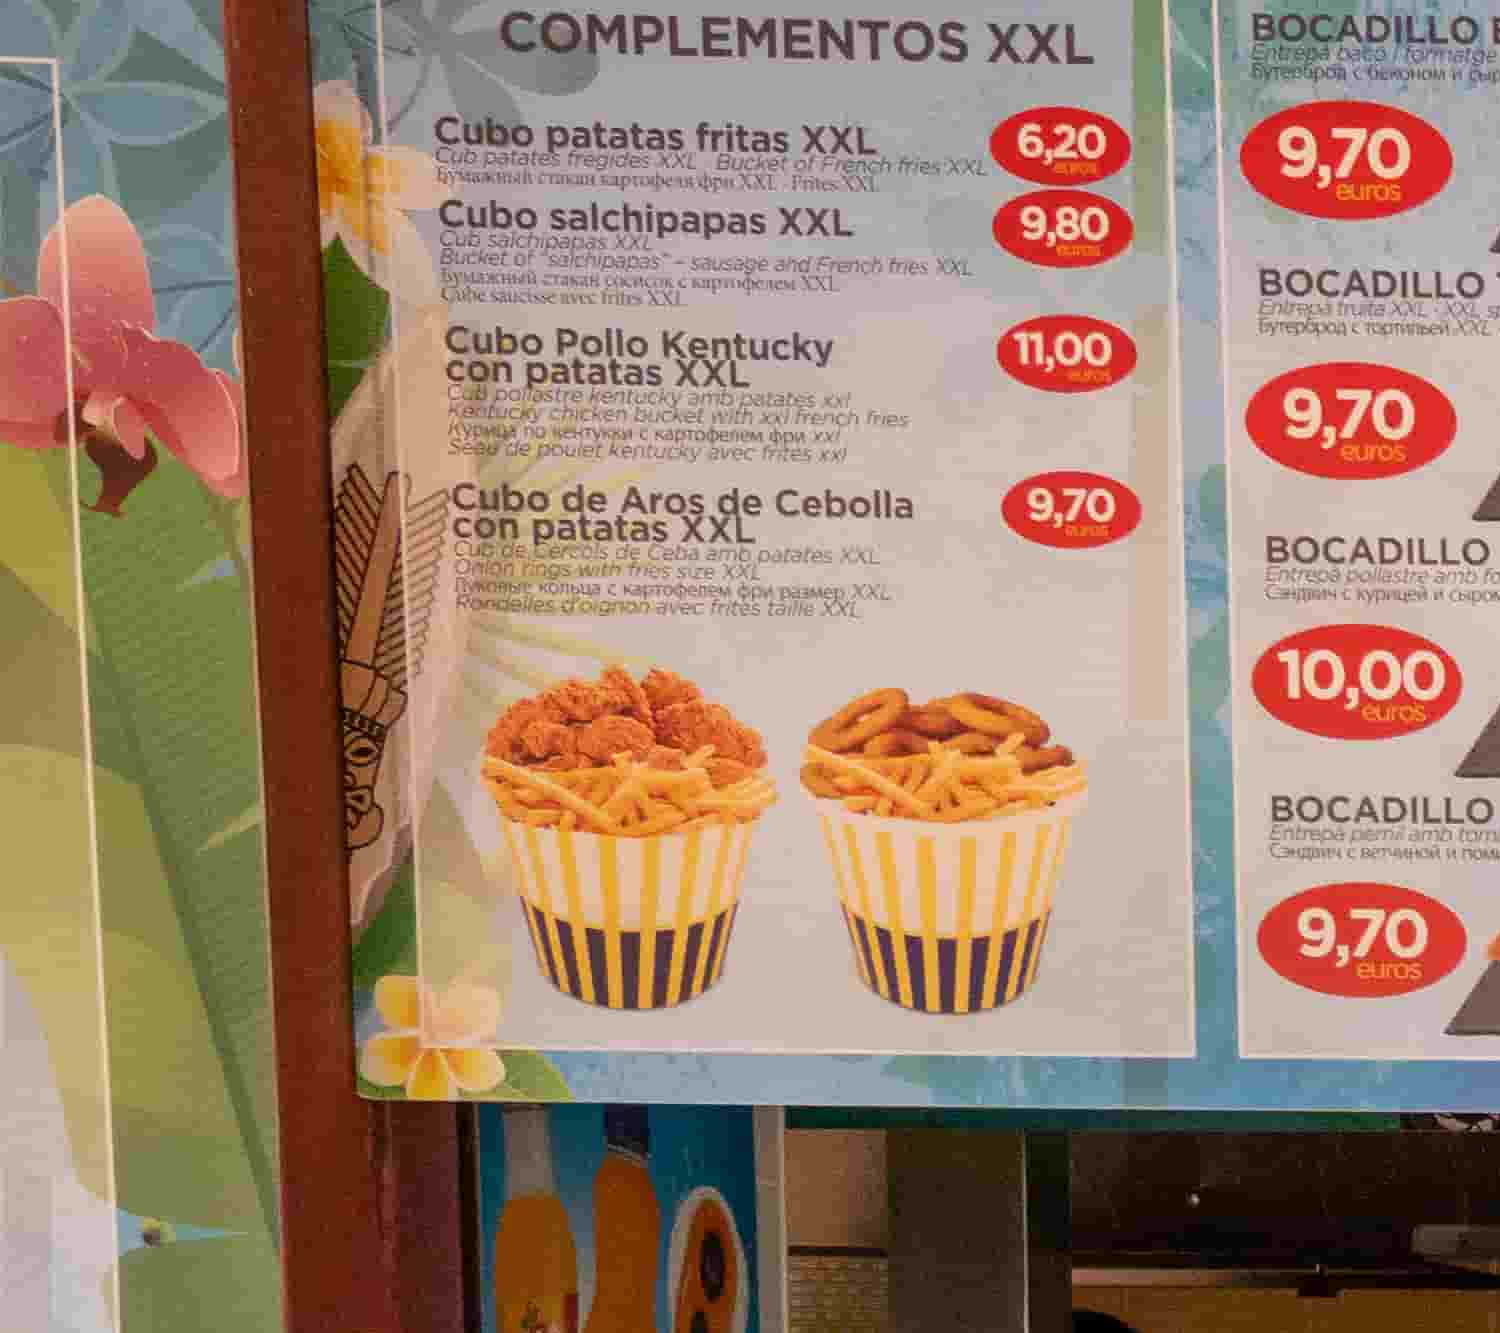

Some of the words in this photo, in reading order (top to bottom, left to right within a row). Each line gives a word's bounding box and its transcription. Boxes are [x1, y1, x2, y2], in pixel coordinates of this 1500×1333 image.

[499, 11, 968, 62] COMPLEMENTOS
[987, 24, 1094, 64] XXL
[1252, 13, 1480, 47] BOCADILLO
[434, 115, 533, 152] Cubo
[546, 122, 684, 153] patatas
[696, 122, 789, 153] fritas
[802, 125, 877, 155] XXL
[1018, 123, 1106, 165] 6,20
[1278, 126, 1410, 188] 9,70
[439, 200, 537, 236] Cubo
[550, 202, 765, 238] salchipapas
[779, 208, 854, 237] XXL
[1020, 206, 1109, 246] 9,80
[1259, 268, 1484, 300] BOCADILLO
[445, 326, 544, 364] Cubo
[552, 328, 648, 365] Pollo
[662, 331, 832, 367] Kentucky
[1013, 332, 1112, 372] 11,00
[445, 360, 512, 389] con
[526, 360, 662, 390] patatas
[675, 362, 750, 387] XXL
[1284, 388, 1414, 449] 9,70
[452, 483, 550, 514] Cubo
[562, 484, 607, 516] de
[622, 487, 704, 516] Aros
[719, 489, 763, 518] de
[776, 489, 912, 518] Cebolla
[1028, 488, 1115, 528] 9,70
[1266, 536, 1490, 567] BOCADILLO
[1278, 647, 1445, 709] 10,00
[1272, 796, 1493, 826] BOCADILLO
[1298, 908, 1428, 967] 9,70
